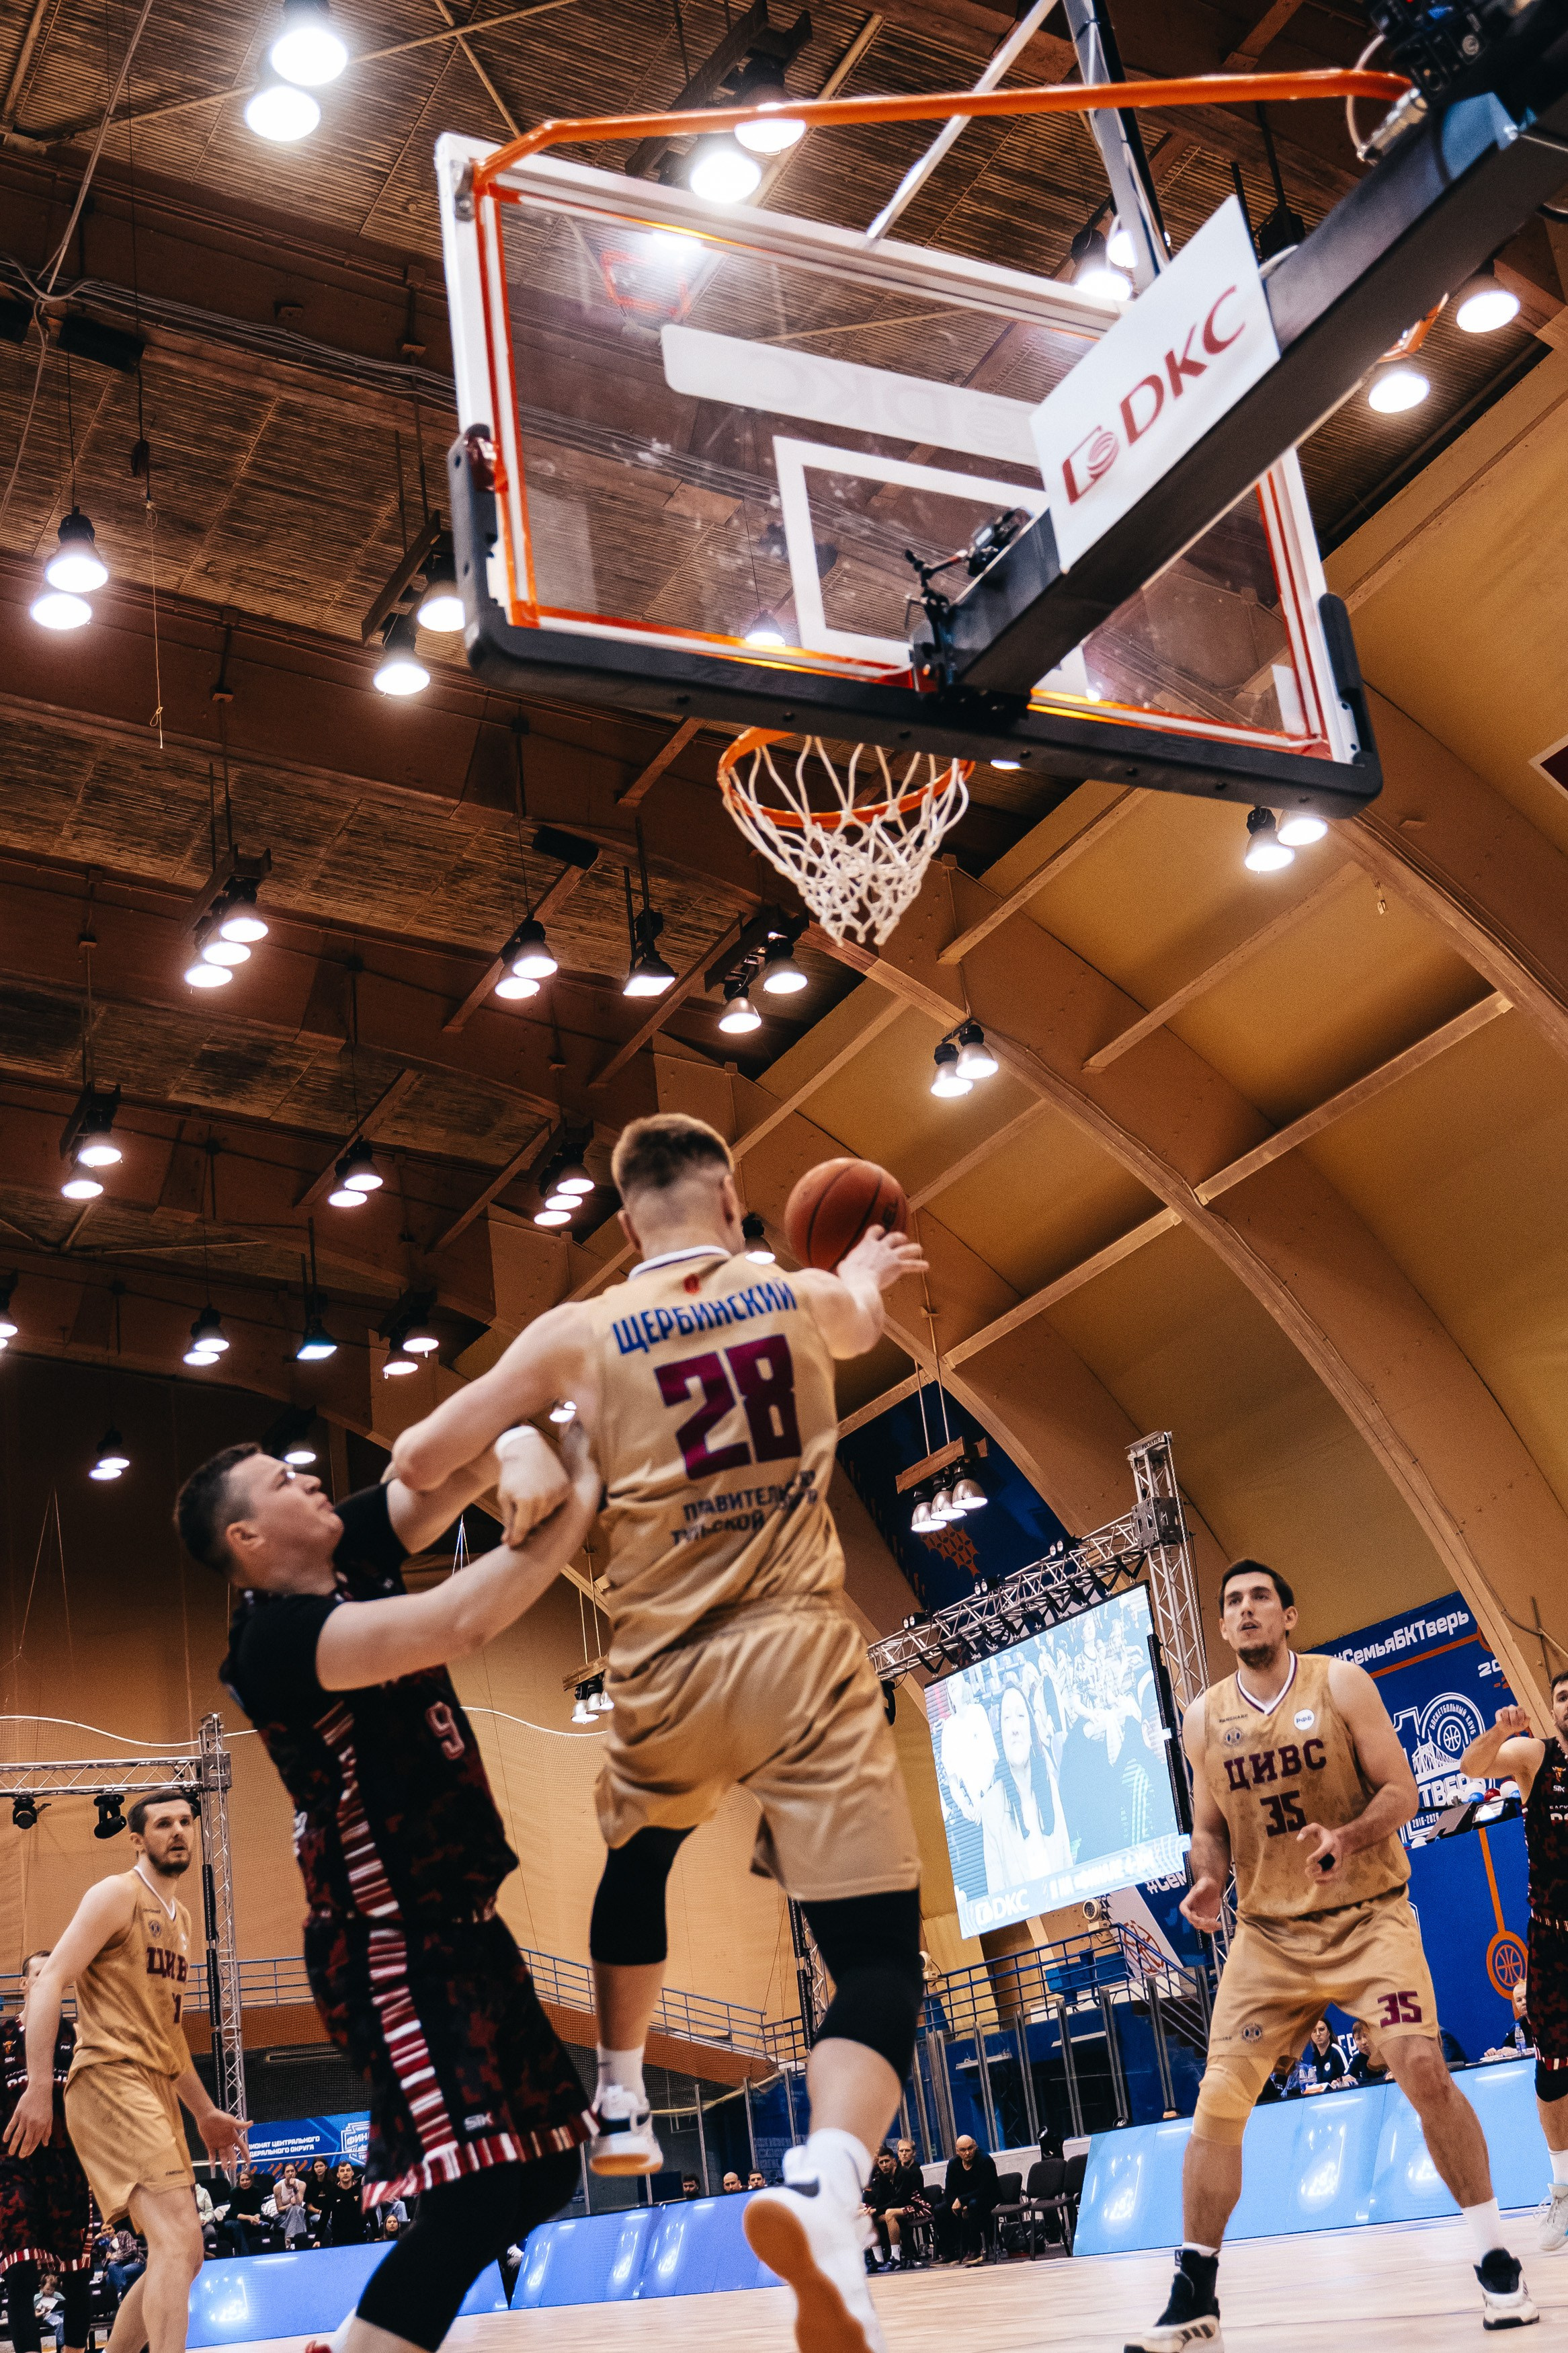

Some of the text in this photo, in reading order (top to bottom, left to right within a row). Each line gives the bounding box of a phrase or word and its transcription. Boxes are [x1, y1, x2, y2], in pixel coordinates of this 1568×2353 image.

[1120, 284, 1245, 446] DKC
[612, 1277, 797, 1355] ЩЕРБИНСКИЙ
[653, 1333, 802, 1480] 28
[425, 1701, 465, 1761] 9
[1223, 1738, 1327, 1792] ЦИВС
[1259, 1789, 1308, 1837] 35
[991, 1888, 1030, 1921] DKC
[1377, 1990, 1423, 2028] 35
[249, 2135, 321, 2151] ИОНАТ ЦЕНТРАЛЬНОГО
[290, 2144, 315, 2153] ОКРУГА
